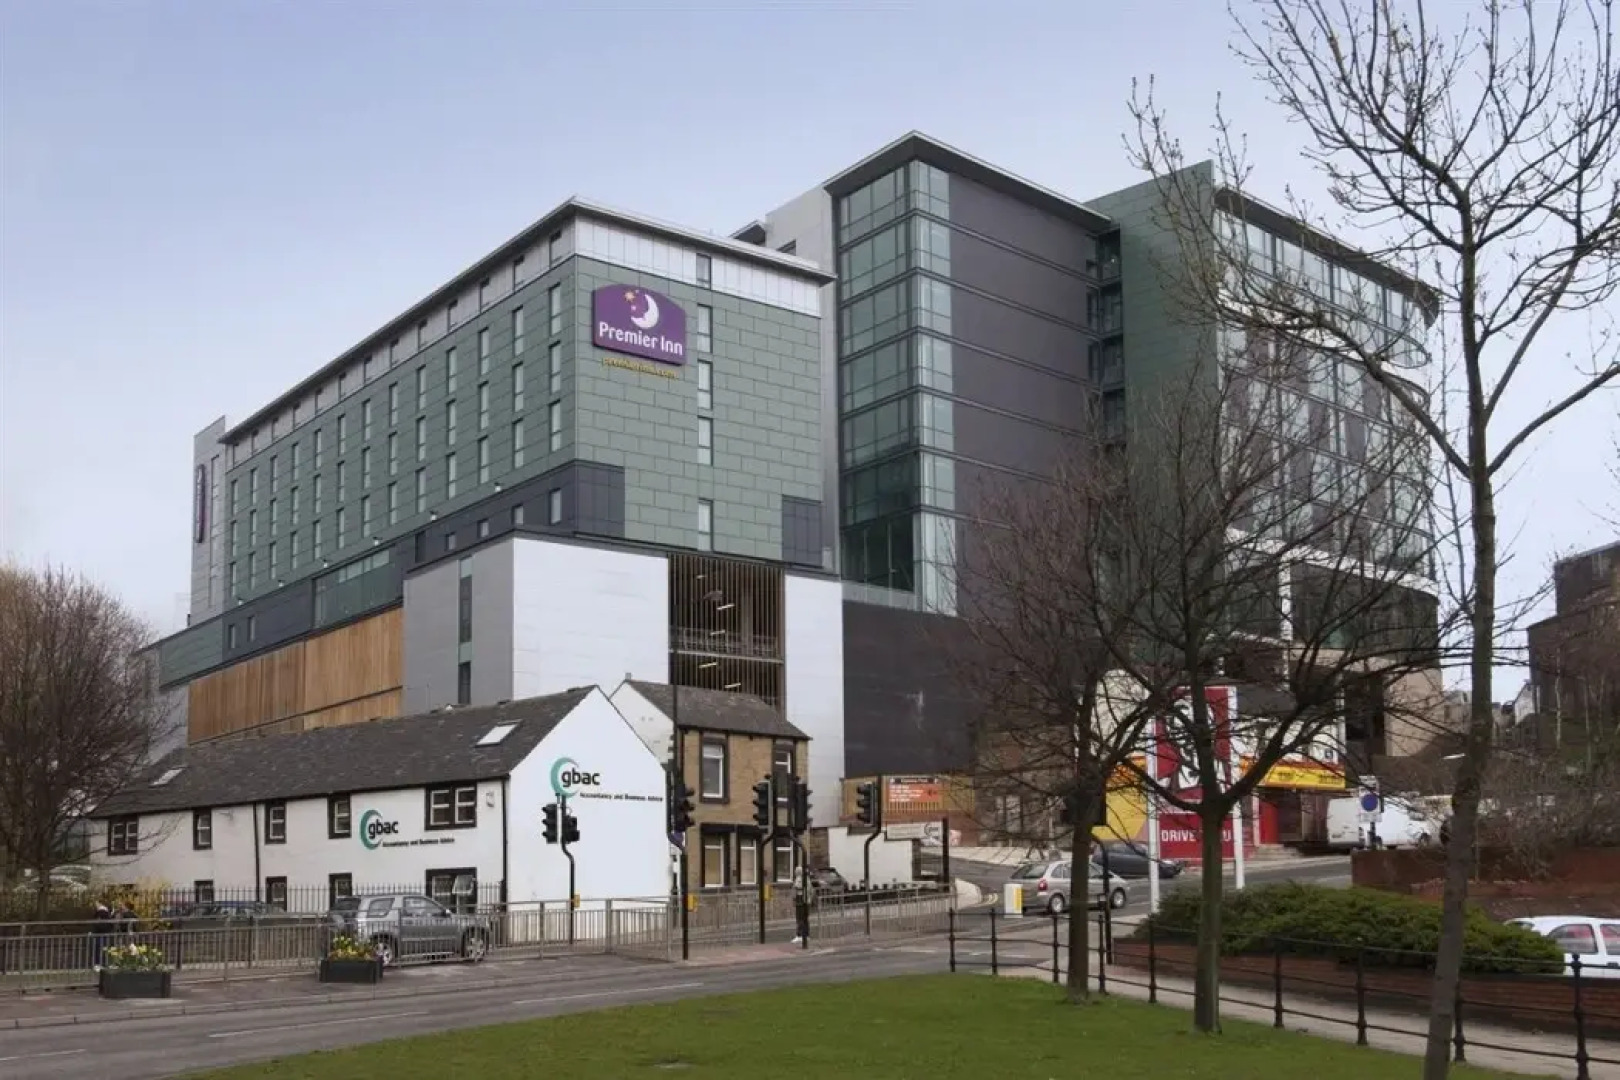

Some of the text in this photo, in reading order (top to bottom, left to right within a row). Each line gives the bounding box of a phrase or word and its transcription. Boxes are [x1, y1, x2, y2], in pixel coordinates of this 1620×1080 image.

[599, 321, 683, 356] Premier Inn
[561, 767, 600, 788] gbac
[368, 819, 399, 840] gbac
[1161, 829, 1197, 842] DRIVE
